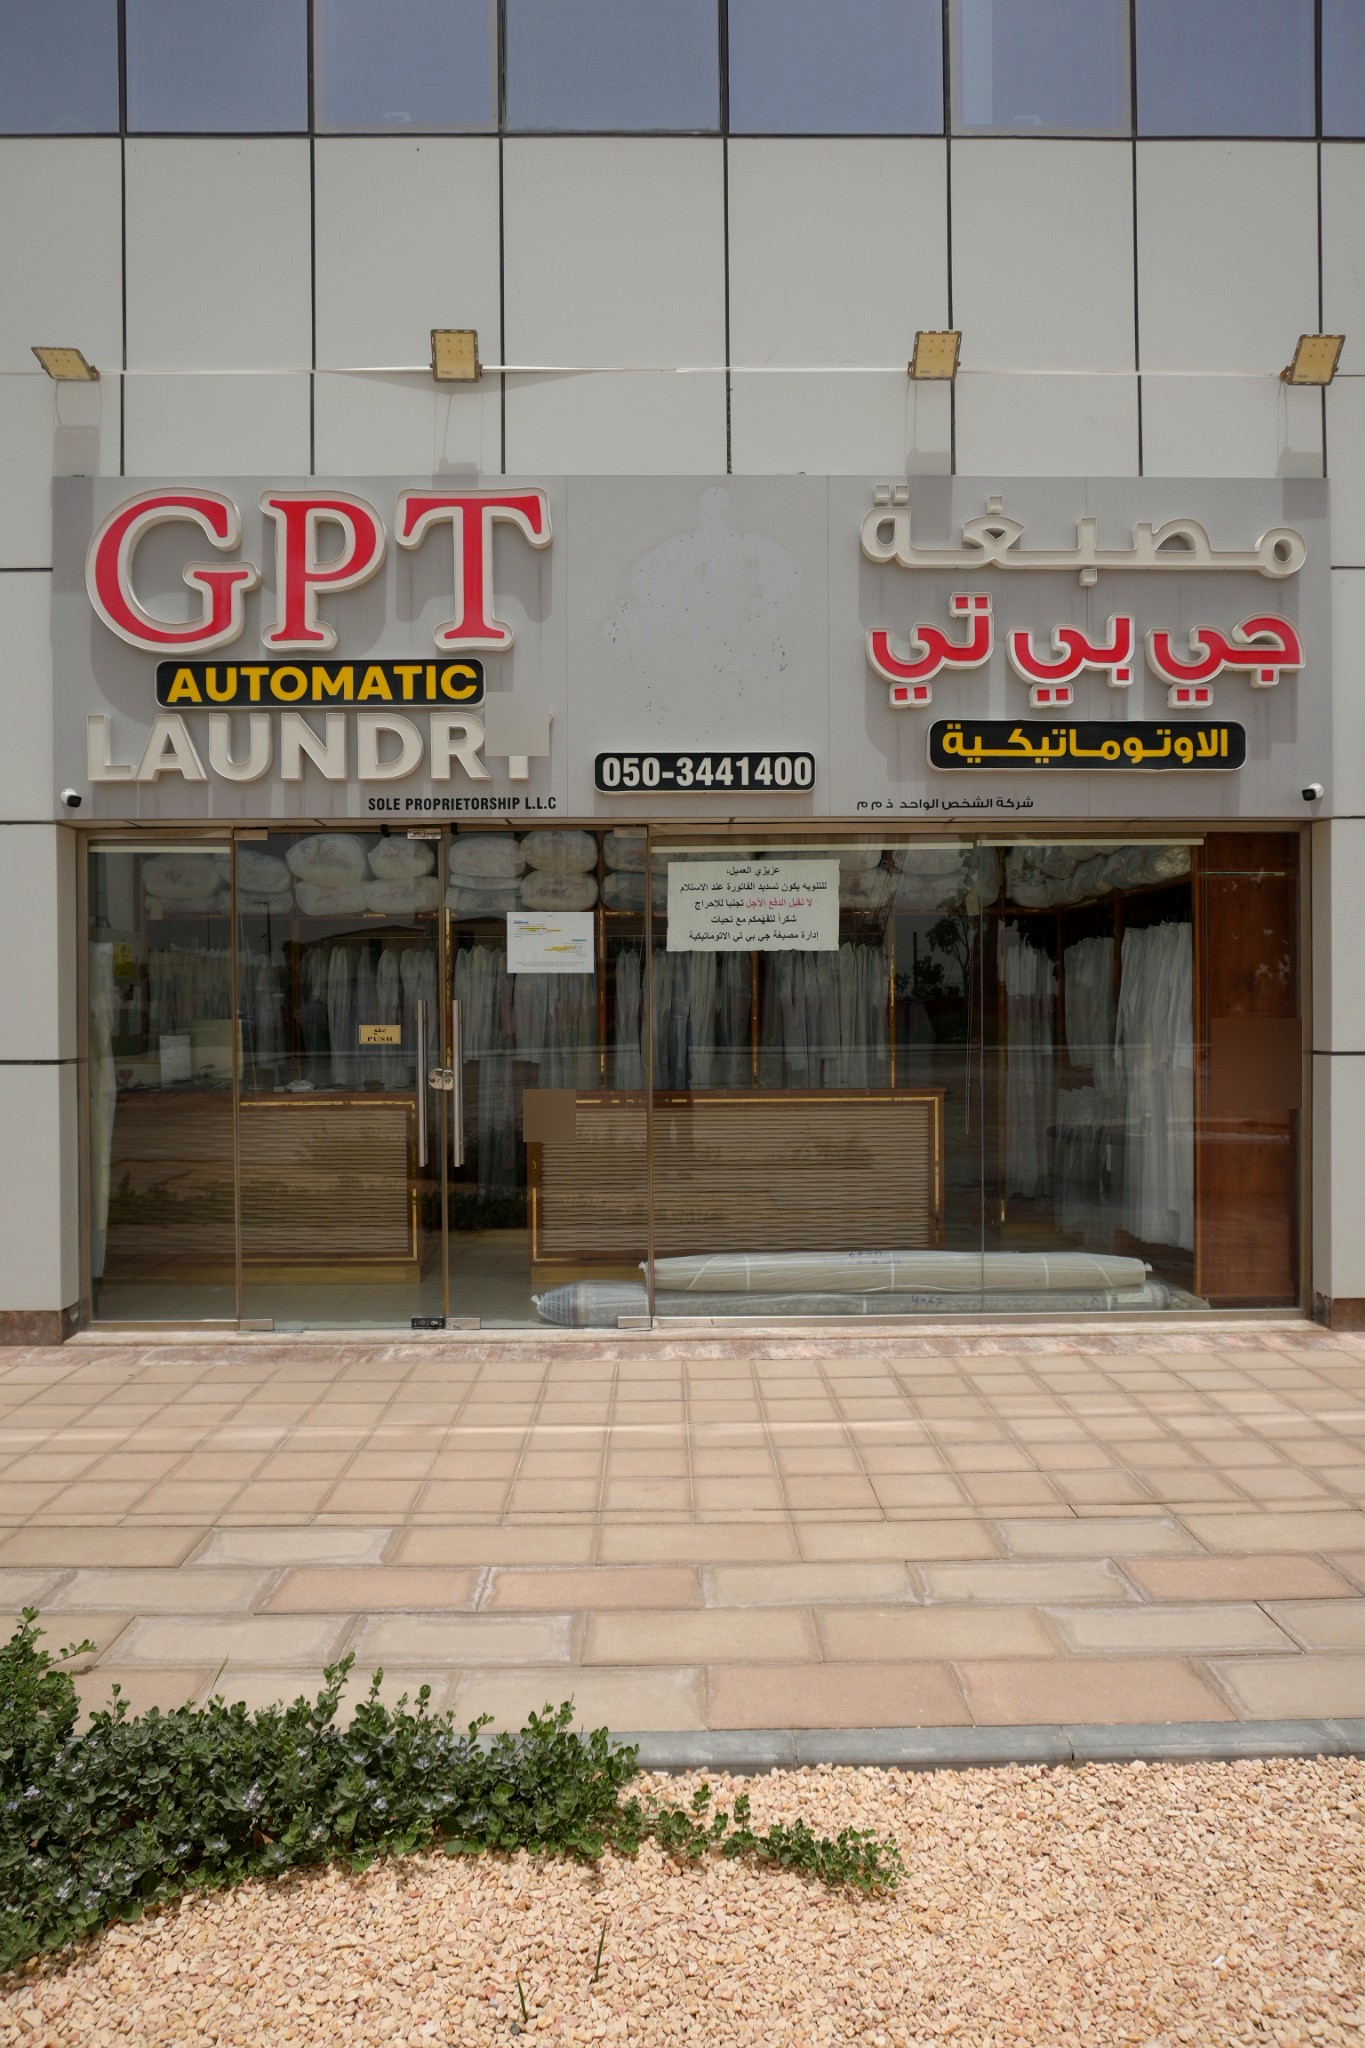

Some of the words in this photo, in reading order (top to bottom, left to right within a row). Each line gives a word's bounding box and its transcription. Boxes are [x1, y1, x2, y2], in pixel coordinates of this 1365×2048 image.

[861, 484, 1306, 586] مصبغة
[86, 487, 552, 652] GPT
[867, 592, 994, 707] تي
[1006, 612, 1134, 707] بي
[1146, 612, 1305, 707] جي
[167, 664, 477, 702] AUTOMATIC
[942, 723, 1228, 763] الاوتوماتيكية
[602, 756, 812, 787] 050-3441400
[368, 798, 400, 811] SOLE
[405, 797, 520, 811] PROPRIETORSHIP
[525, 796, 556, 809] L.L.C
[900, 798, 939, 810] الواحد
[941, 796, 993, 810] الشخص
[996, 796, 1034, 810] شركة
[711, 883, 724, 891] عند
[755, 866, 780, 876] عزيزي
